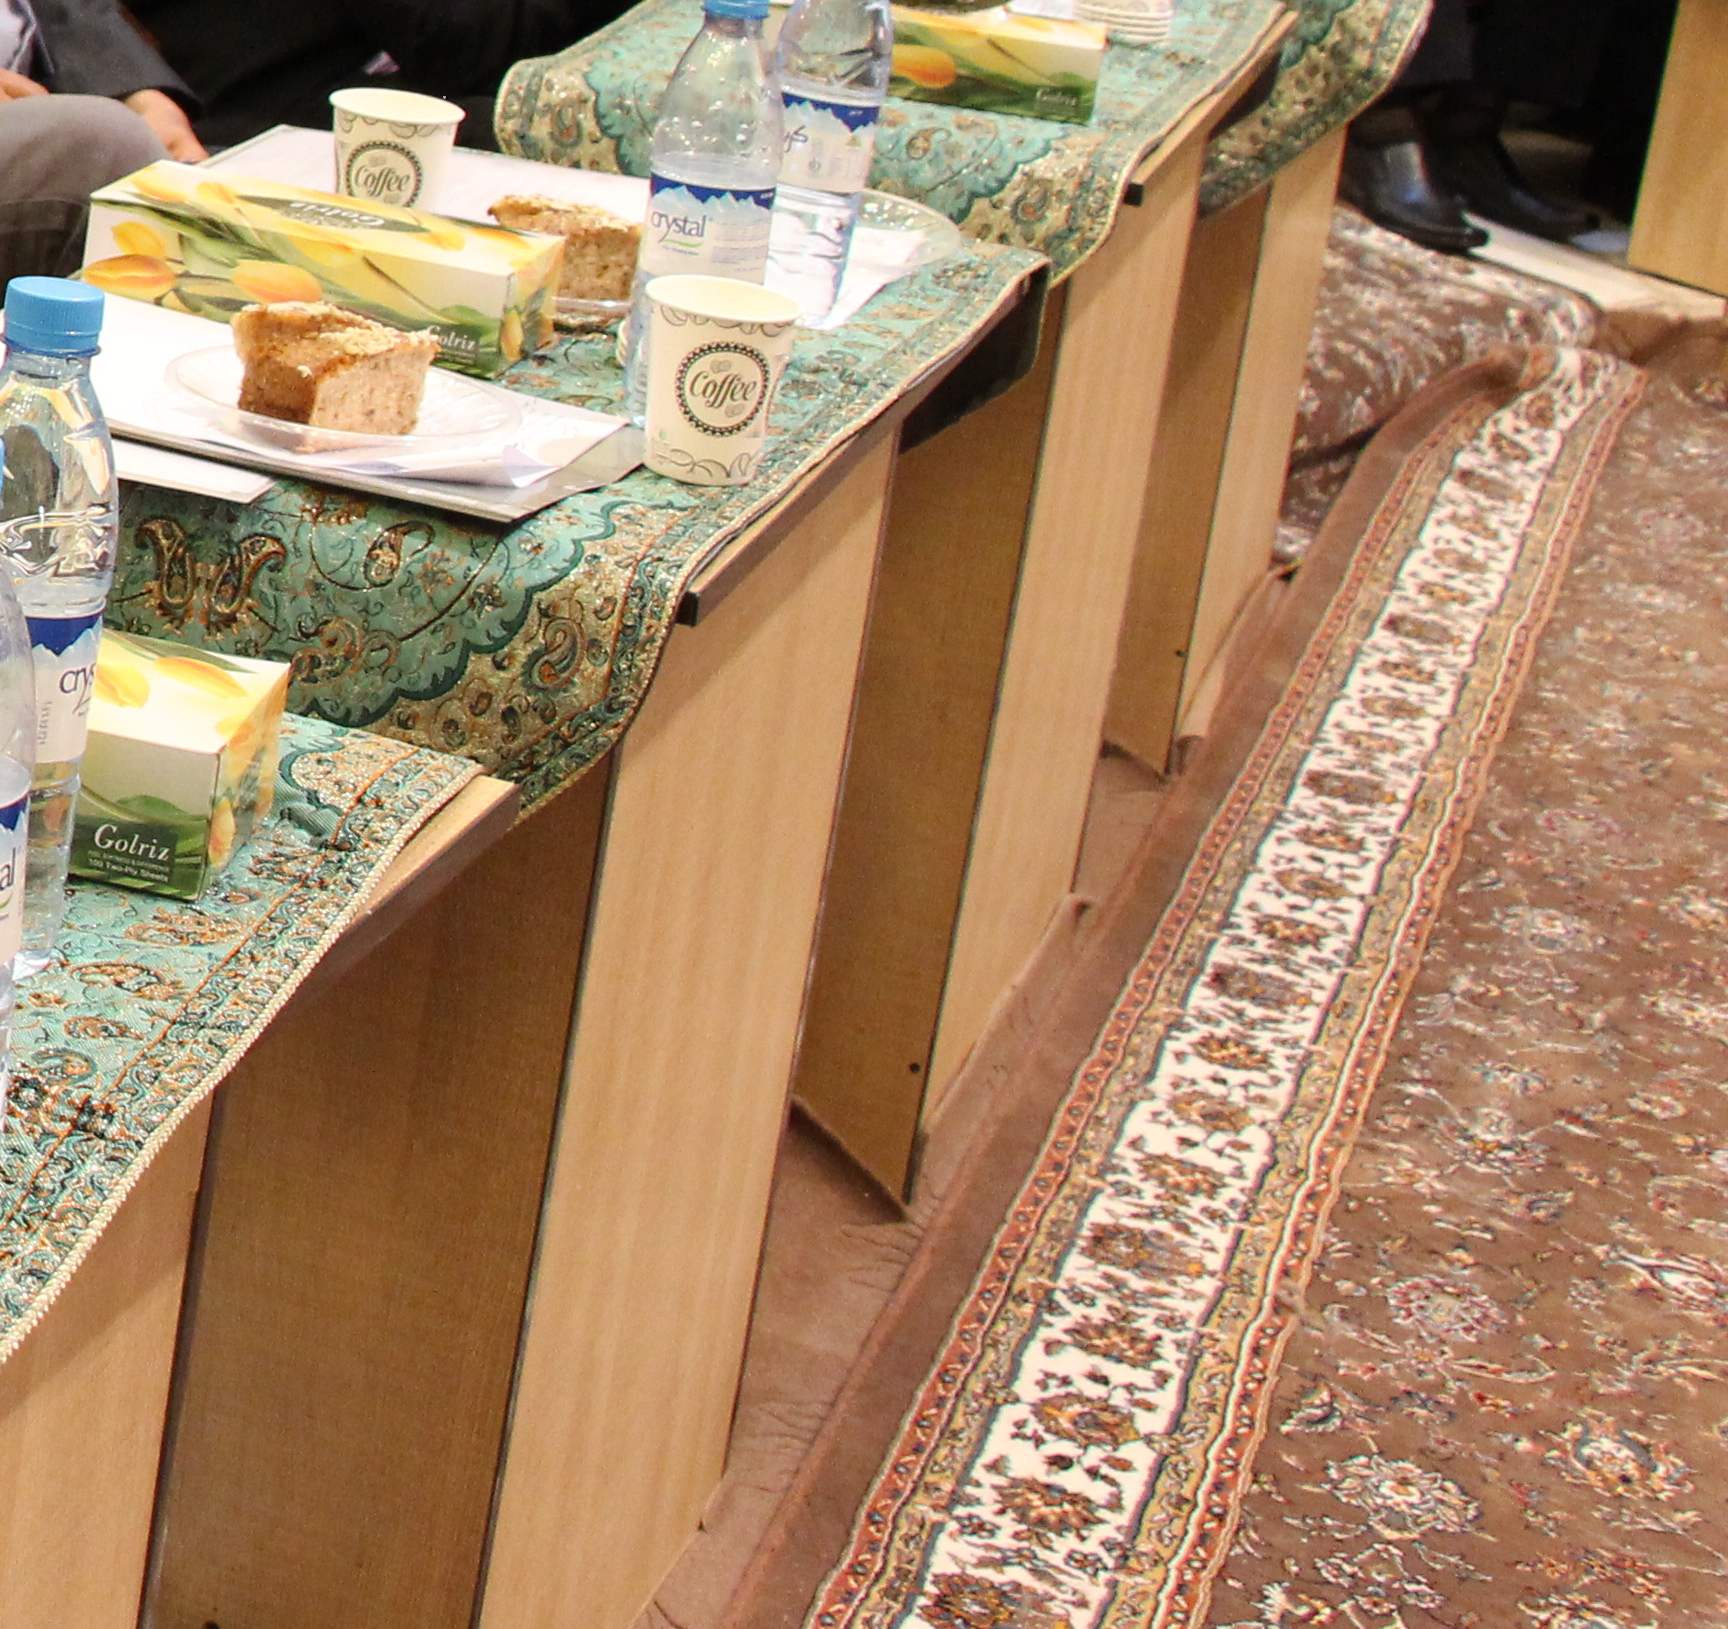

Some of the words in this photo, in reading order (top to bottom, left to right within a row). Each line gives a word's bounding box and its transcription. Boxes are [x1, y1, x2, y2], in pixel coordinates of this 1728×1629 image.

[354, 165, 411, 198] Coffee
[651, 211, 708, 243] crystal
[689, 370, 758, 409] Coffee
[94, 823, 171, 862] Golriz
